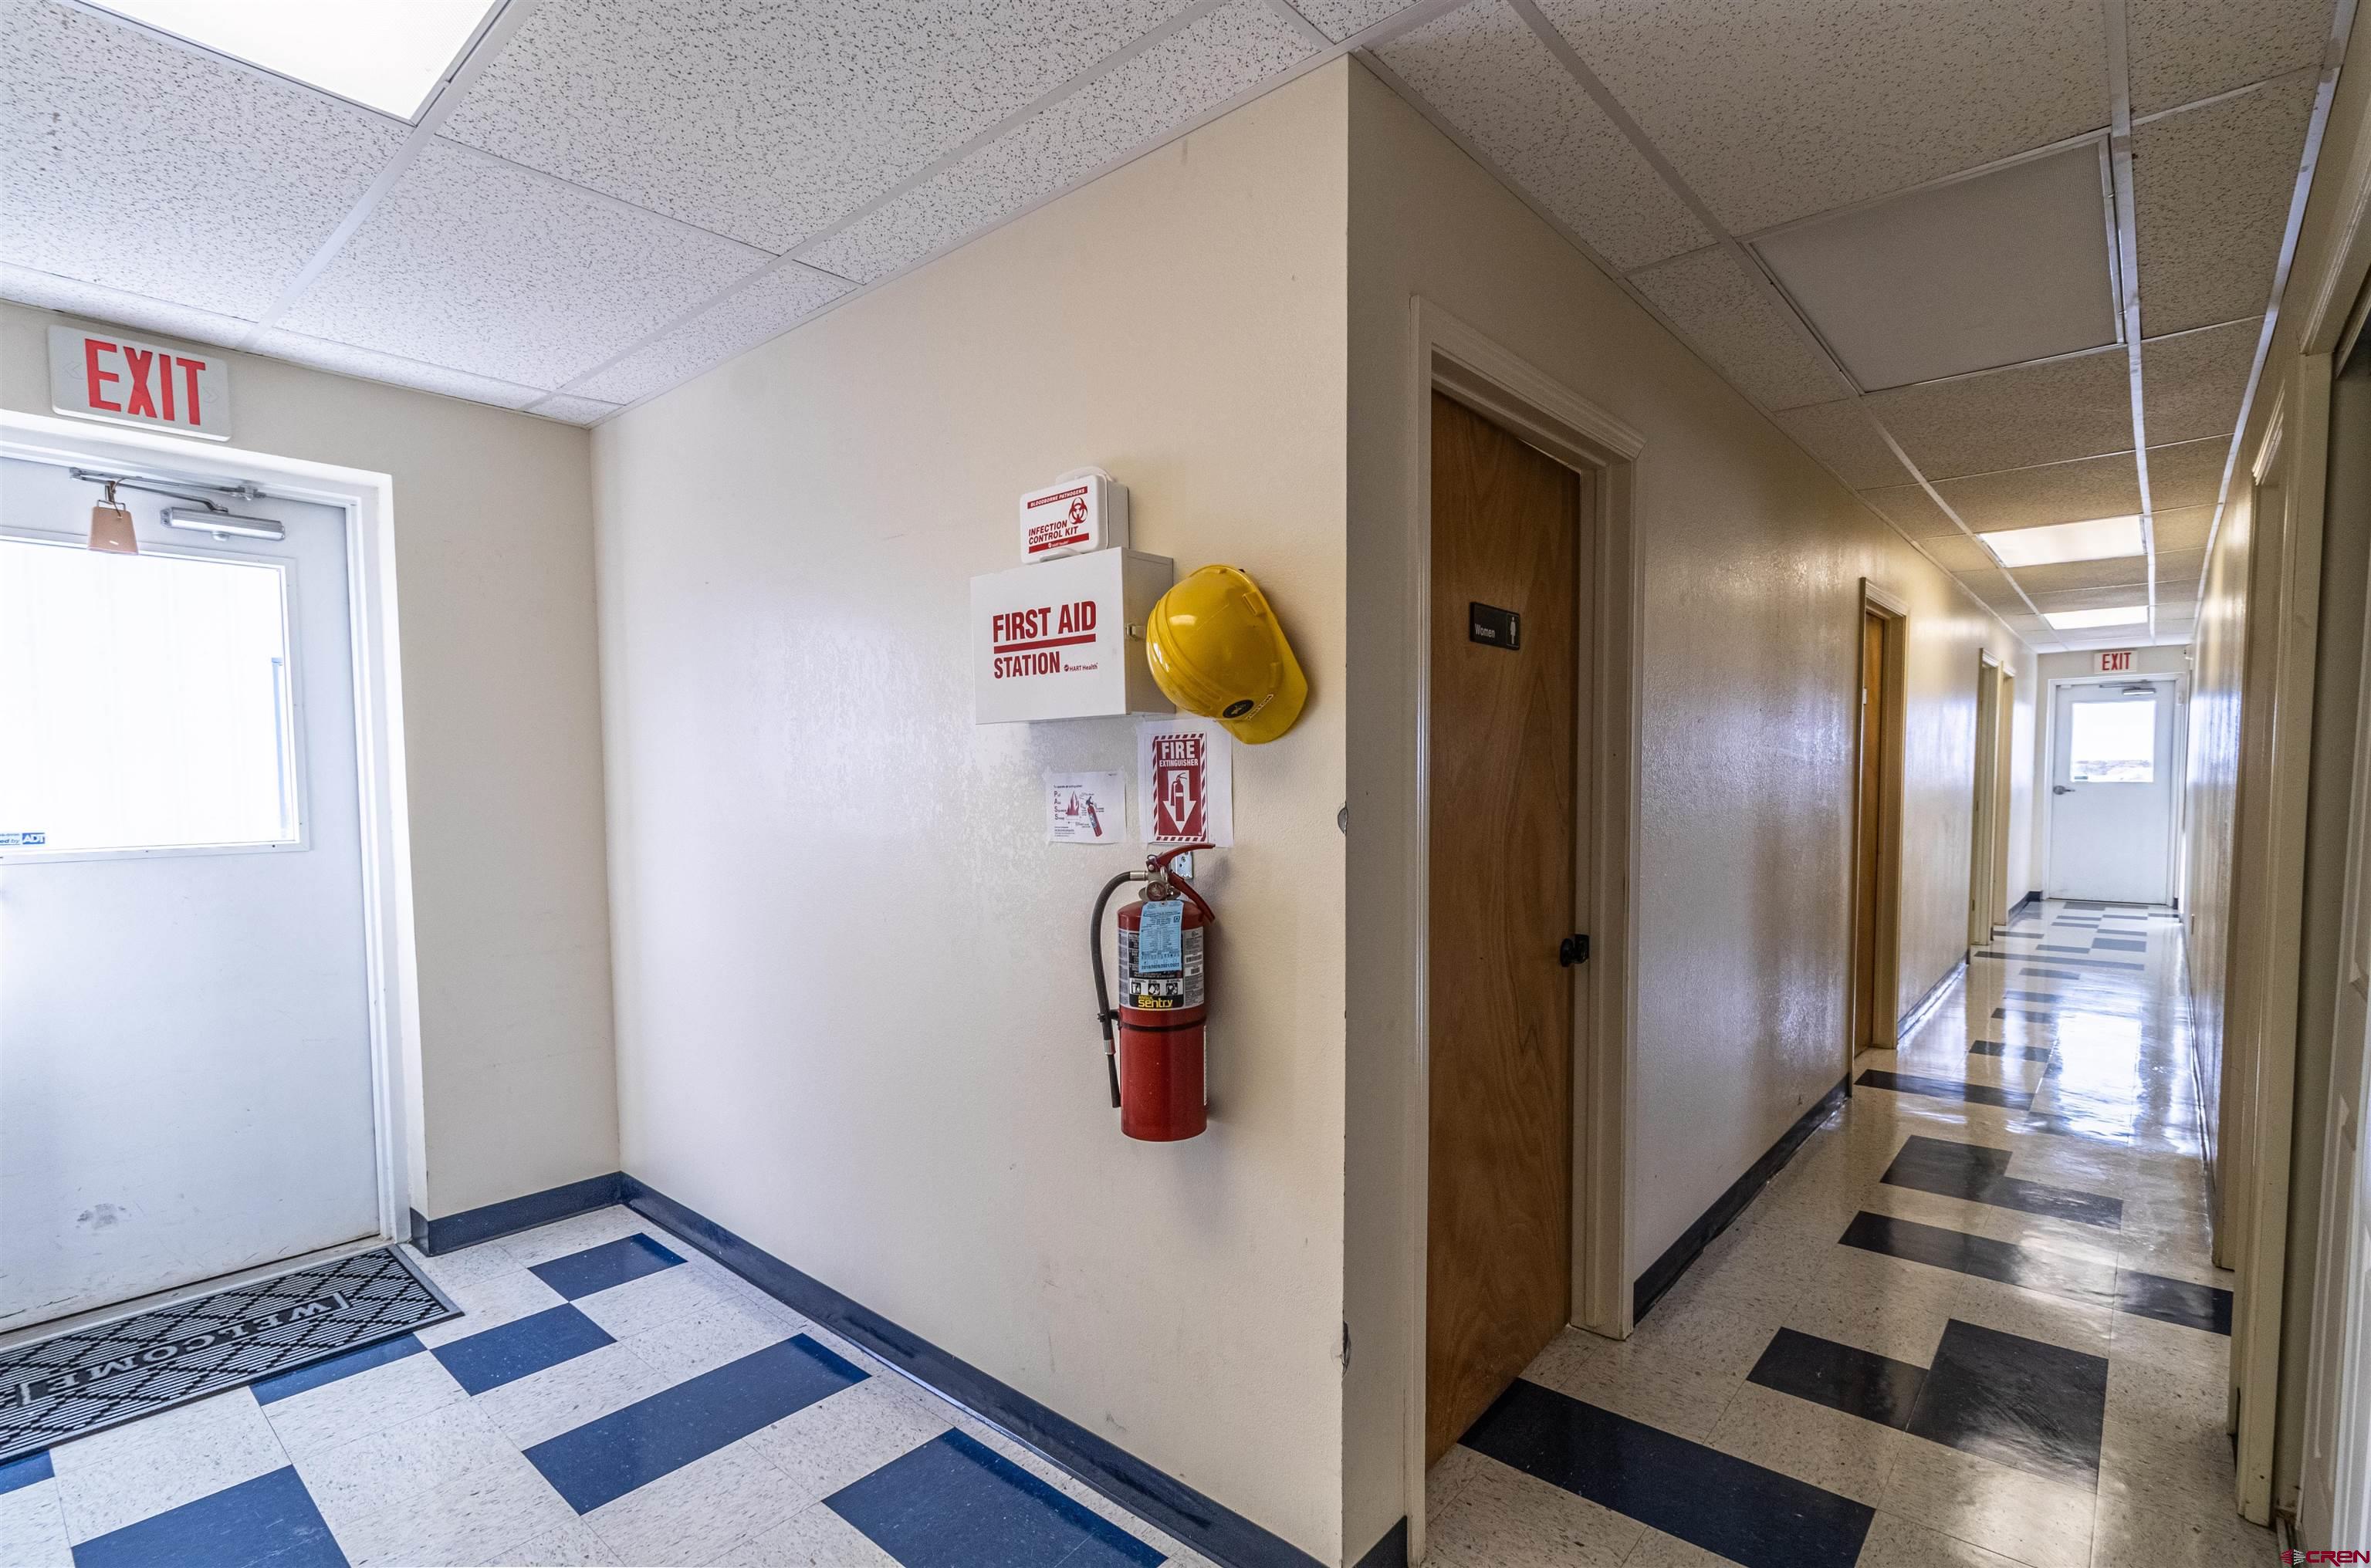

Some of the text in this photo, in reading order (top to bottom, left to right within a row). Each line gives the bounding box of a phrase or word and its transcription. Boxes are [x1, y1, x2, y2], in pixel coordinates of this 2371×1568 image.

[84, 338, 206, 426] EXIT
[1030, 488, 1085, 507] BLOODBORNE PATHOGENS
[1028, 520, 1067, 536] INFECTION
[1029, 530, 1063, 545] CONTROL
[1065, 525, 1078, 536] KIT
[993, 600, 1097, 643] FIRST AID
[1475, 623, 1496, 638] Women
[993, 651, 1060, 679] STATION
[2102, 652, 2132, 671] EXIT
[1161, 741, 1196, 759] FIRE
[1159, 759, 1199, 767] EXTINGUISHER
[23, 833, 45, 843] ADT
[1138, 998, 1173, 1008] sentry
[47, 1302, 333, 1391] WELCOME
